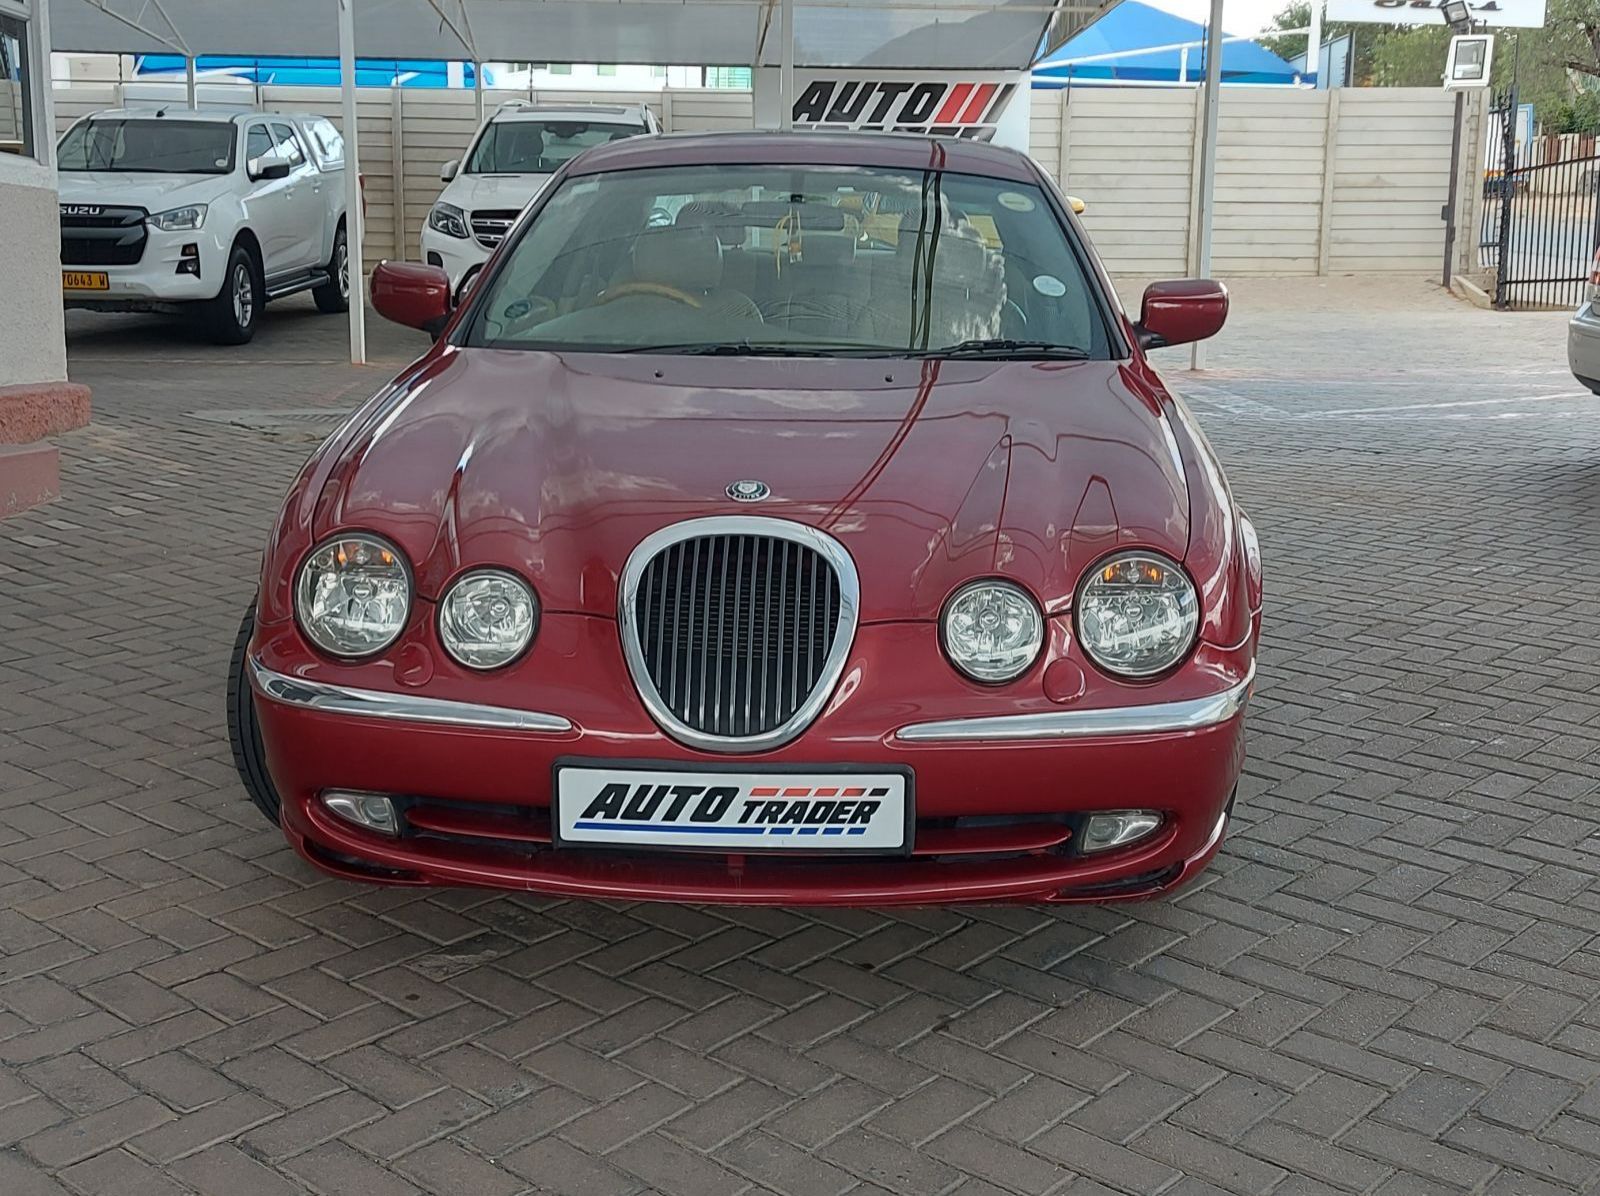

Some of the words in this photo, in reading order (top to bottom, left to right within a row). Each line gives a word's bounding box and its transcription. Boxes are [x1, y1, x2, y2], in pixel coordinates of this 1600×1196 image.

[792, 80, 949, 123] AUTO
[579, 783, 741, 823] AUTO
[737, 800, 882, 825] TRADER
